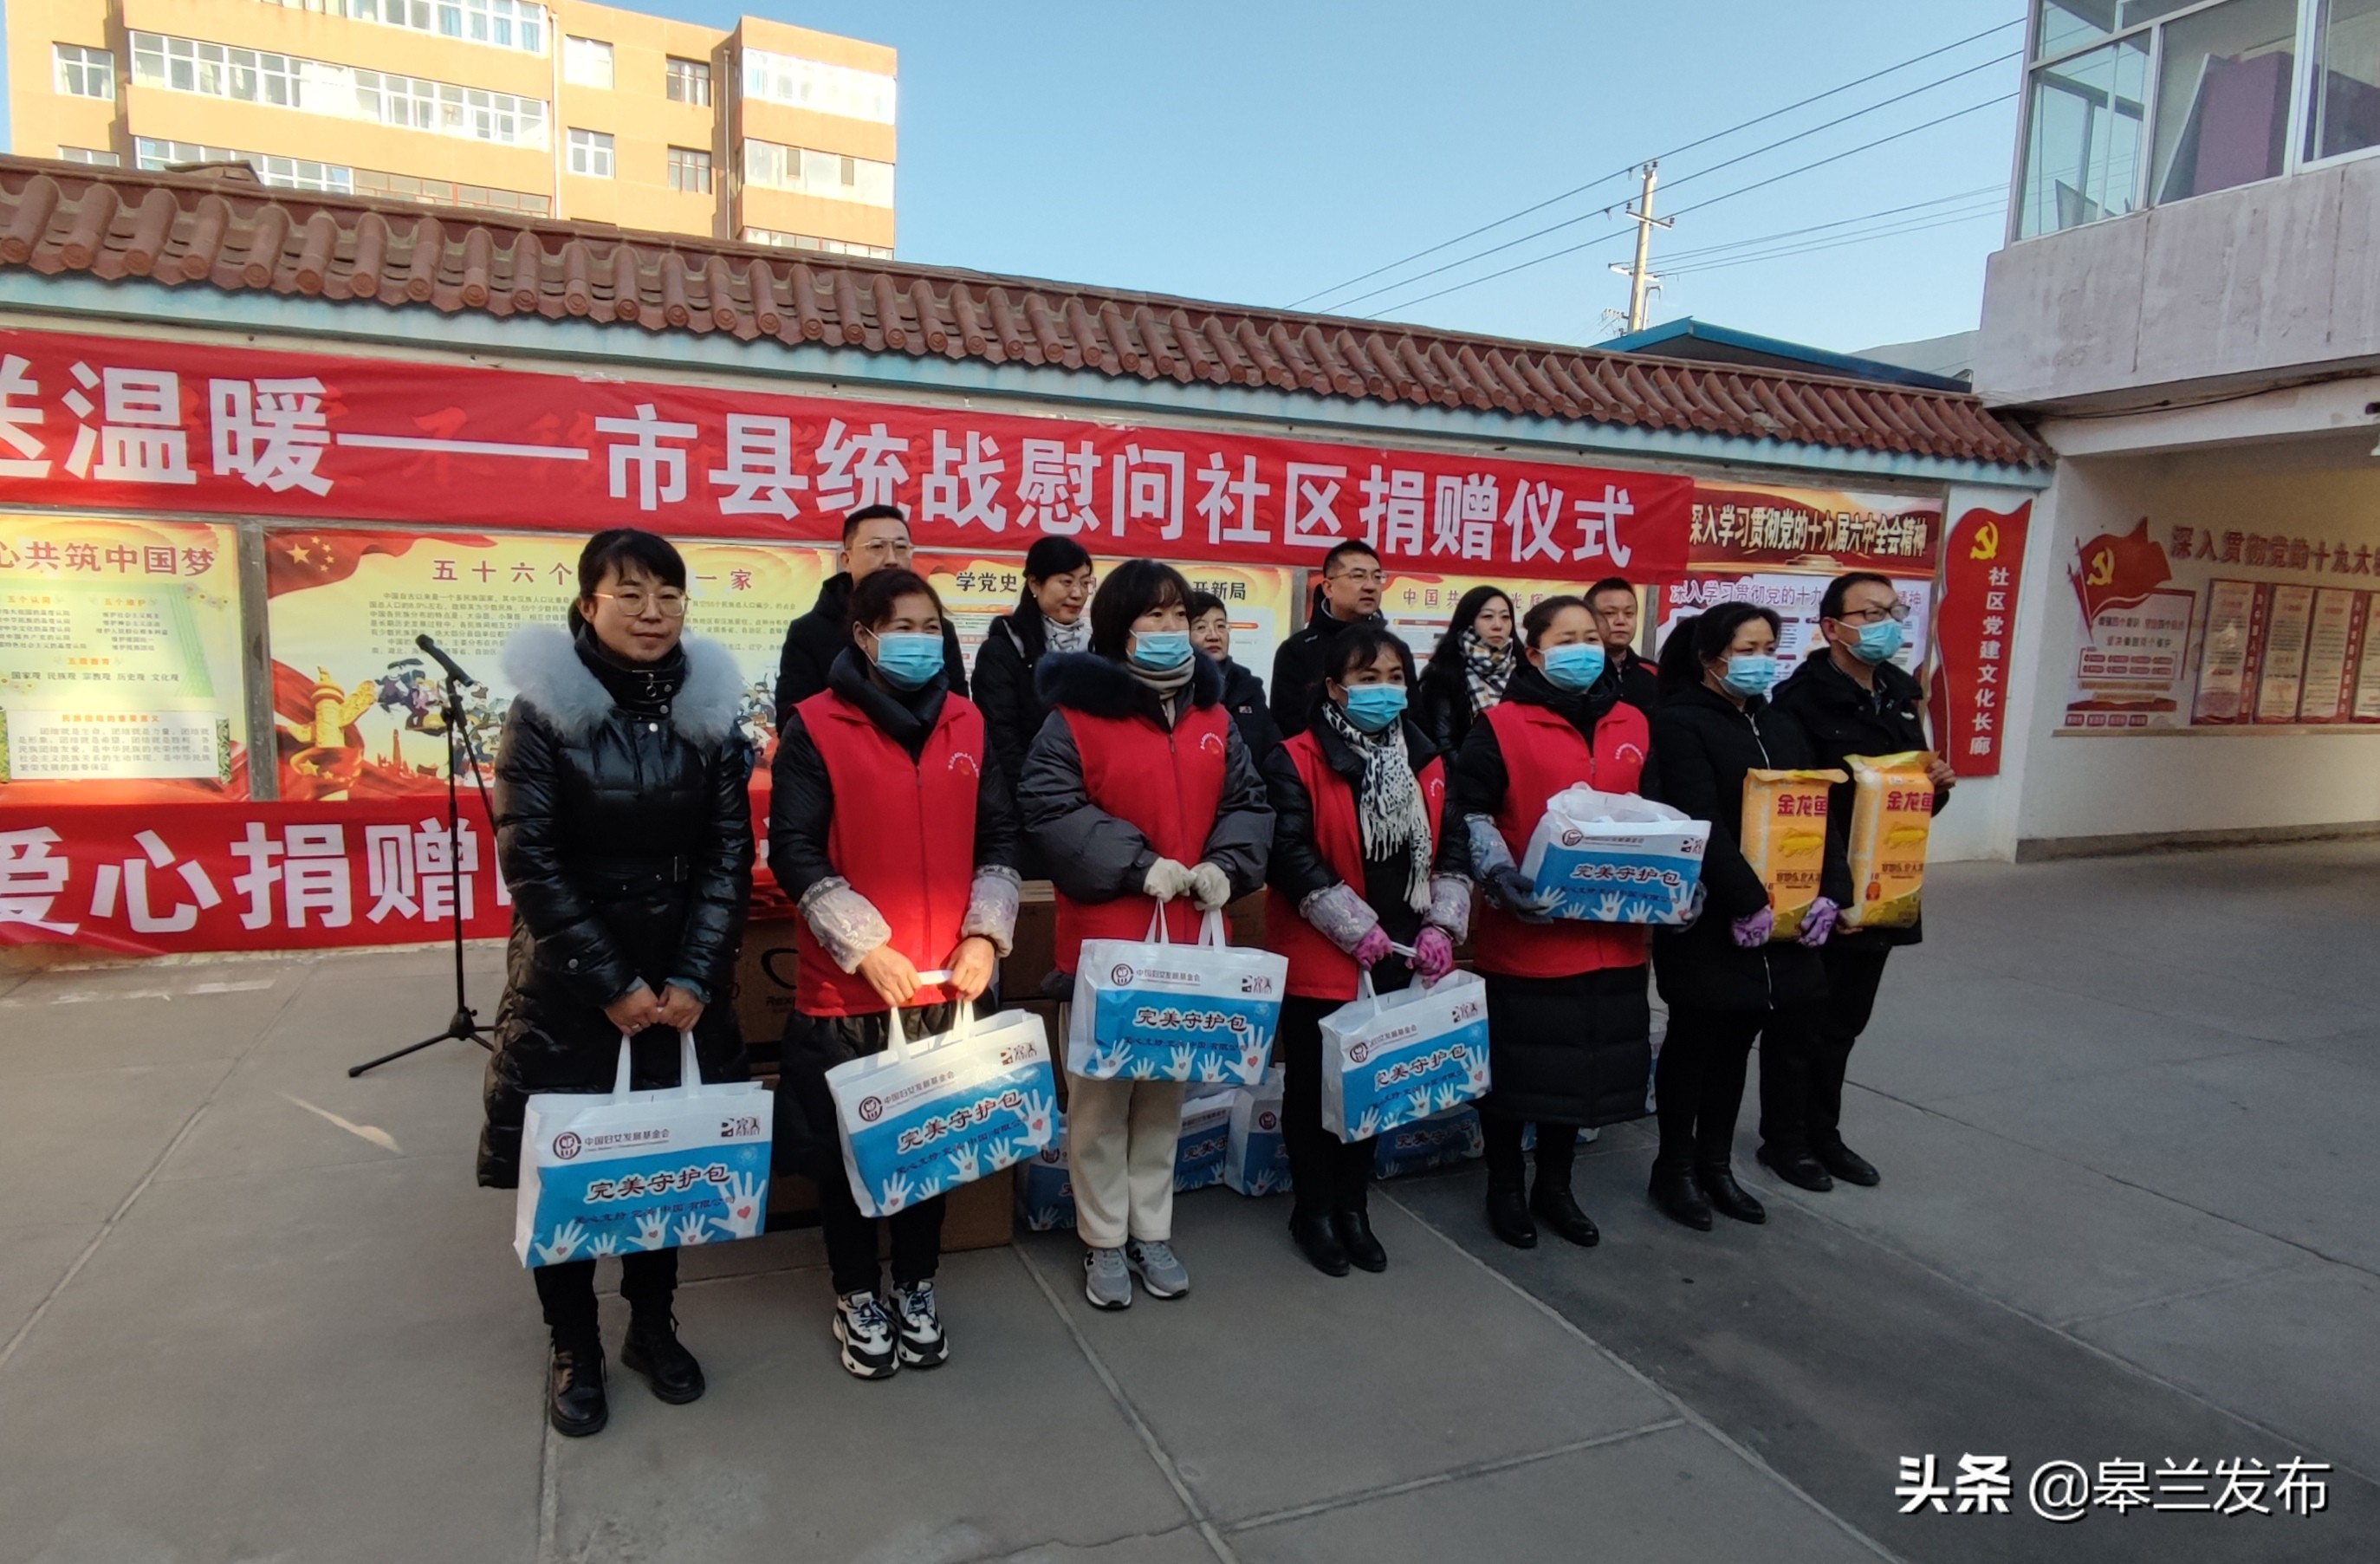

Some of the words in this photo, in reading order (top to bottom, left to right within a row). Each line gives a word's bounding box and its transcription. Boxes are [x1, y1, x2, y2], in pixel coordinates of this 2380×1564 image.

[1689, 505, 1928, 557] 深入学习贯彻党的十九届六中全会精神
[432, 560, 572, 587] 五十六个
[696, 568, 752, 591] 一家
[957, 571, 1017, 593] 学党史
[1968, 565, 2010, 756] 社区党建文化长廊
[0, 817, 512, 936] 爱心捐赠
[1571, 864, 1681, 886] 完美守护包
[1134, 1008, 1248, 1032] 完美守护包
[1376, 1045, 1468, 1088] 完美守护包
[584, 1128, 670, 1146] 中国妇女发展基金会
[899, 1092, 1023, 1151] 完美守护包
[587, 1165, 731, 1202] 完美守护包
